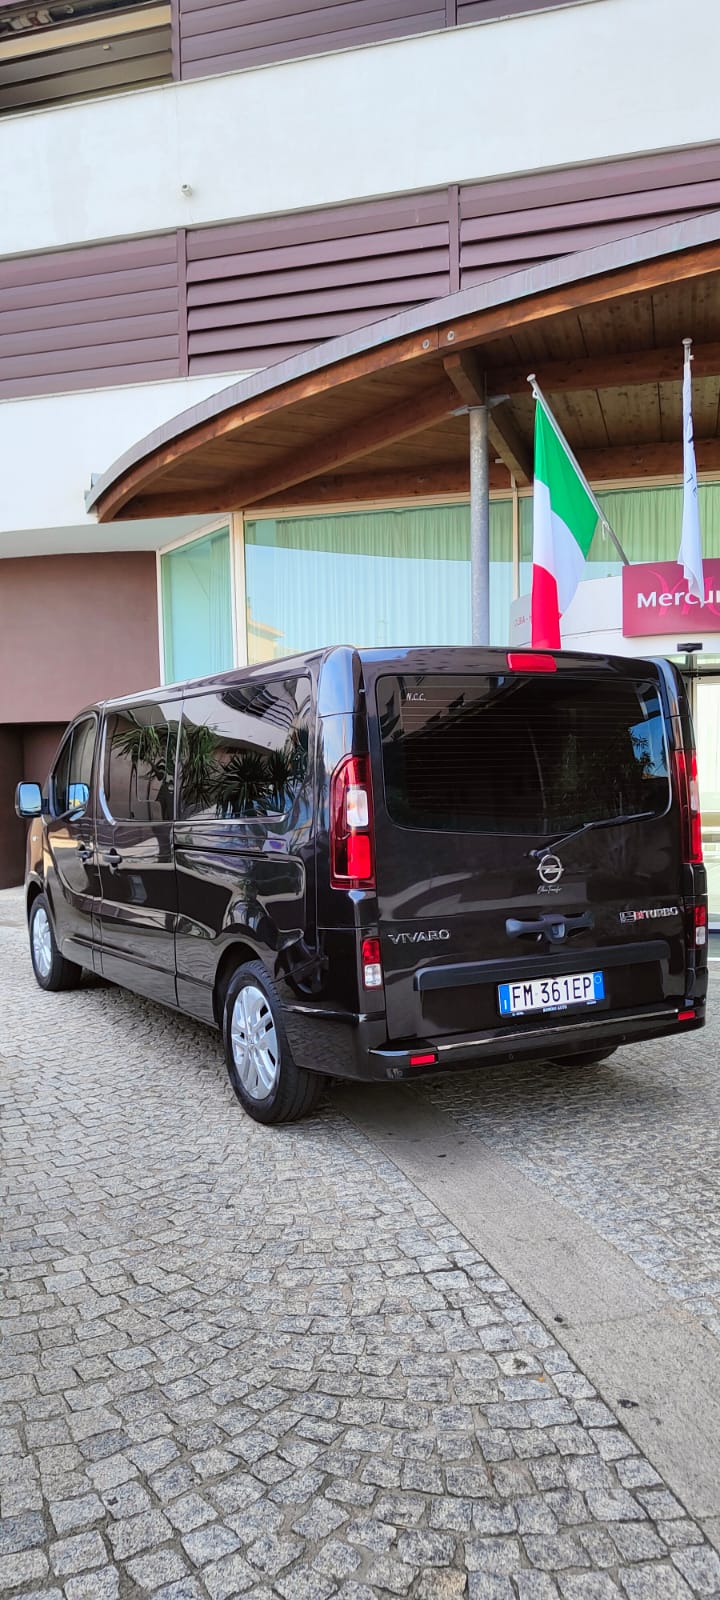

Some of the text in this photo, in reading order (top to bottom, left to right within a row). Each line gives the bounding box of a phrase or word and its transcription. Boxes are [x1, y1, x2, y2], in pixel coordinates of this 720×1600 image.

[387, 929, 450, 945] VIVARO
[512, 983, 534, 1008] FM
[540, 976, 592, 1004] 361EP
